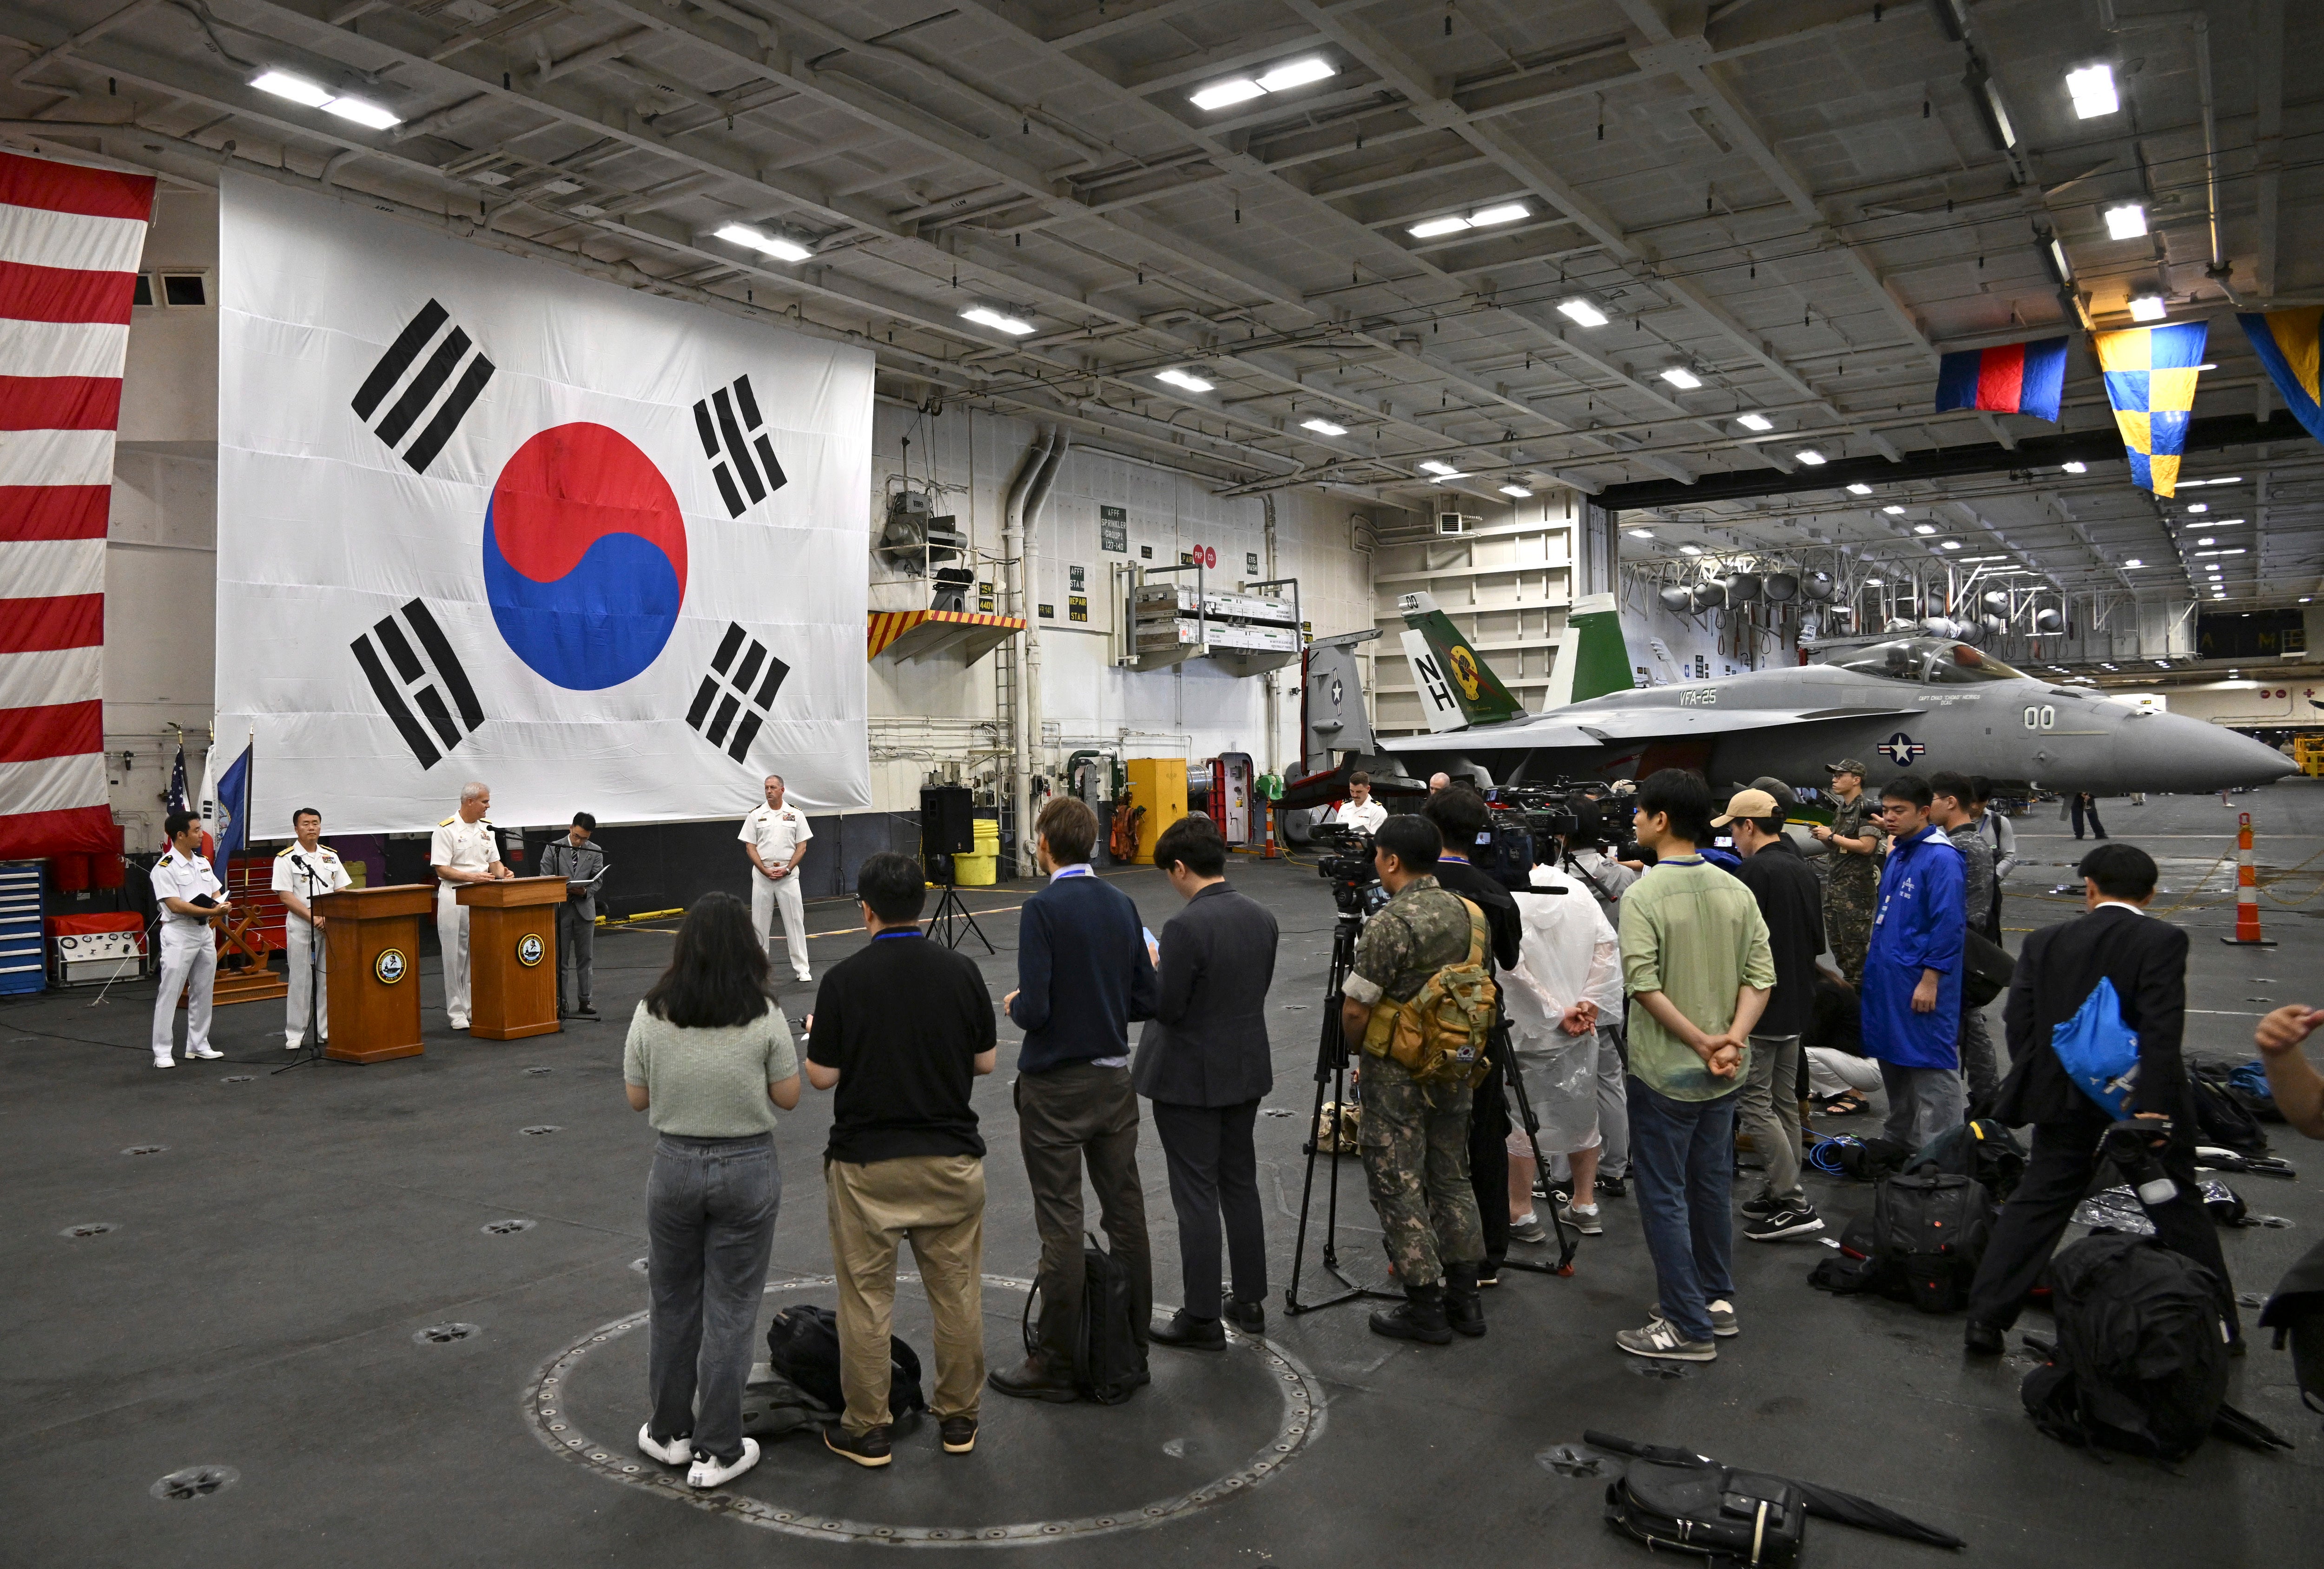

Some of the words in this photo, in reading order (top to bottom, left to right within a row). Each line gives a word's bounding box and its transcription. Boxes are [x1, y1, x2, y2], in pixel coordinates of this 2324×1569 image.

[1108, 508, 1119, 517] AFFF
[1101, 518, 1126, 529] SPRINKLER
[1105, 530, 1120, 540] GROUP
[1106, 541, 1123, 550] 127-140
[1071, 567, 1083, 576] AFFF
[1070, 580, 1079, 588] STA
[980, 600, 993, 610] 440V
[1069, 597, 1086, 606] REPAIR
[1071, 612, 1081, 620] STA
[1680, 688, 1717, 705] VFA-25
[2023, 705, 2055, 729] 00
[1651, 1332, 1675, 1350] N
